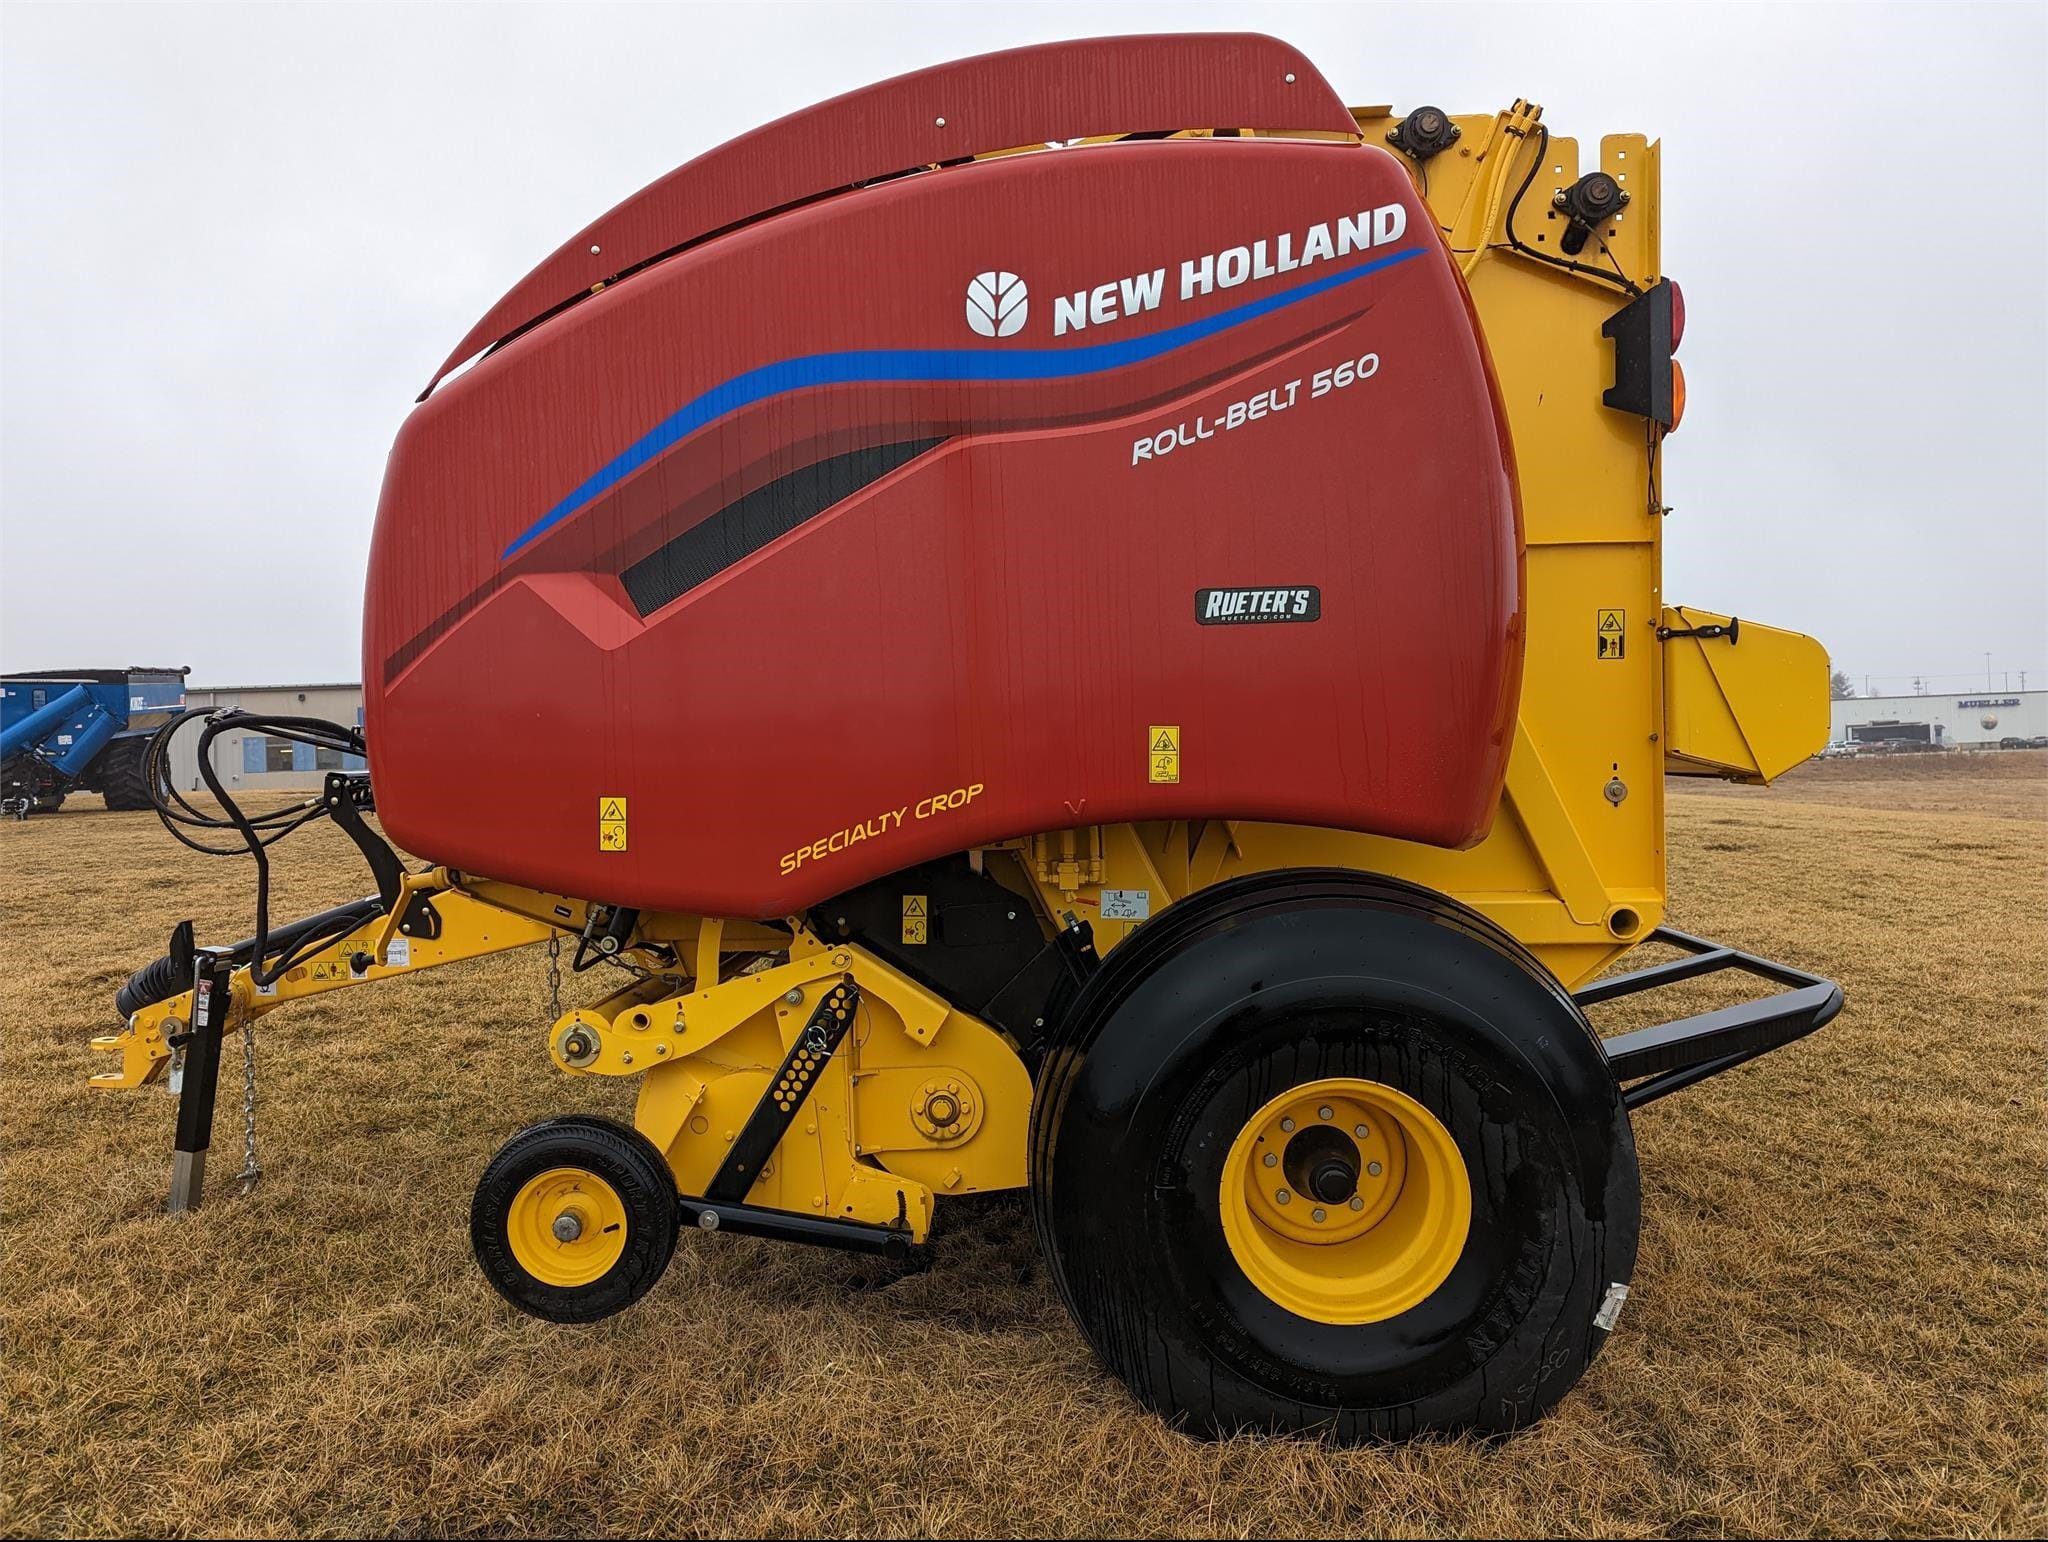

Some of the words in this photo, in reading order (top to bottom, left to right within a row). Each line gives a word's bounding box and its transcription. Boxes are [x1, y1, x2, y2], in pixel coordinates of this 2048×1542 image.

[1053, 267, 1166, 337] NEW
[1180, 202, 1408, 301] HOLLAND
[1131, 379, 1302, 466] ROLL-BELT
[1311, 352, 1380, 399] 560
[1204, 590, 1310, 619] RUETER'S
[1958, 698, 2021, 709] MUELLER
[780, 806, 908, 876] SPECIALTY
[914, 783, 984, 820] CROP
[1465, 1238, 1552, 1363] TITAN
